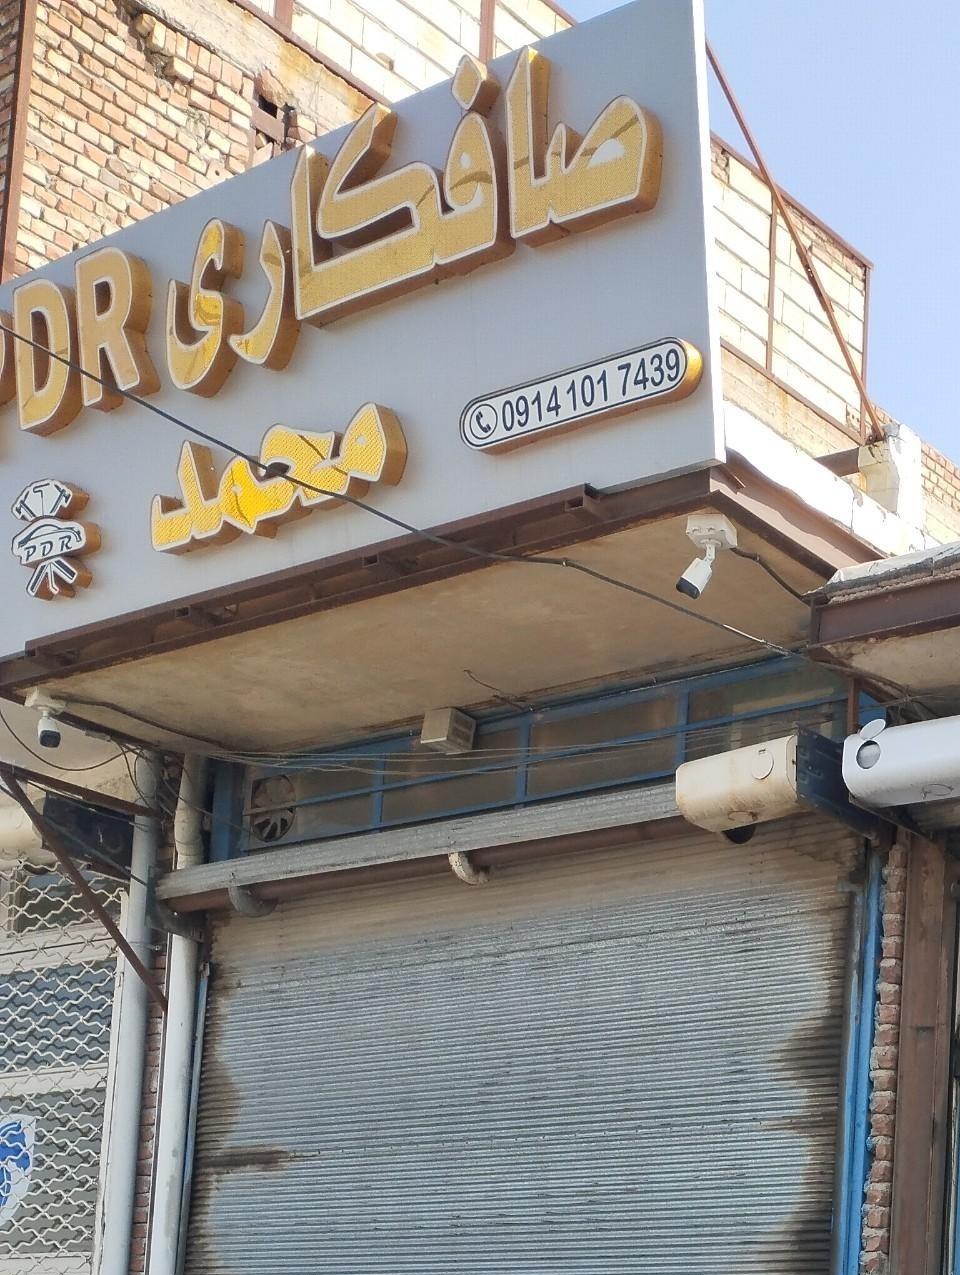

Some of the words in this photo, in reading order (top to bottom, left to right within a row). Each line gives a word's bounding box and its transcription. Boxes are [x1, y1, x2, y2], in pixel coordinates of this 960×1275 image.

[167, 46, 652, 390] صافکاری
[0, 246, 142, 431] DR
[501, 385, 562, 432] 0914
[566, 369, 608, 412] 101
[618, 349, 682, 397] 7439
[24, 534, 73, 562] PDR
[151, 401, 392, 551] محمد
